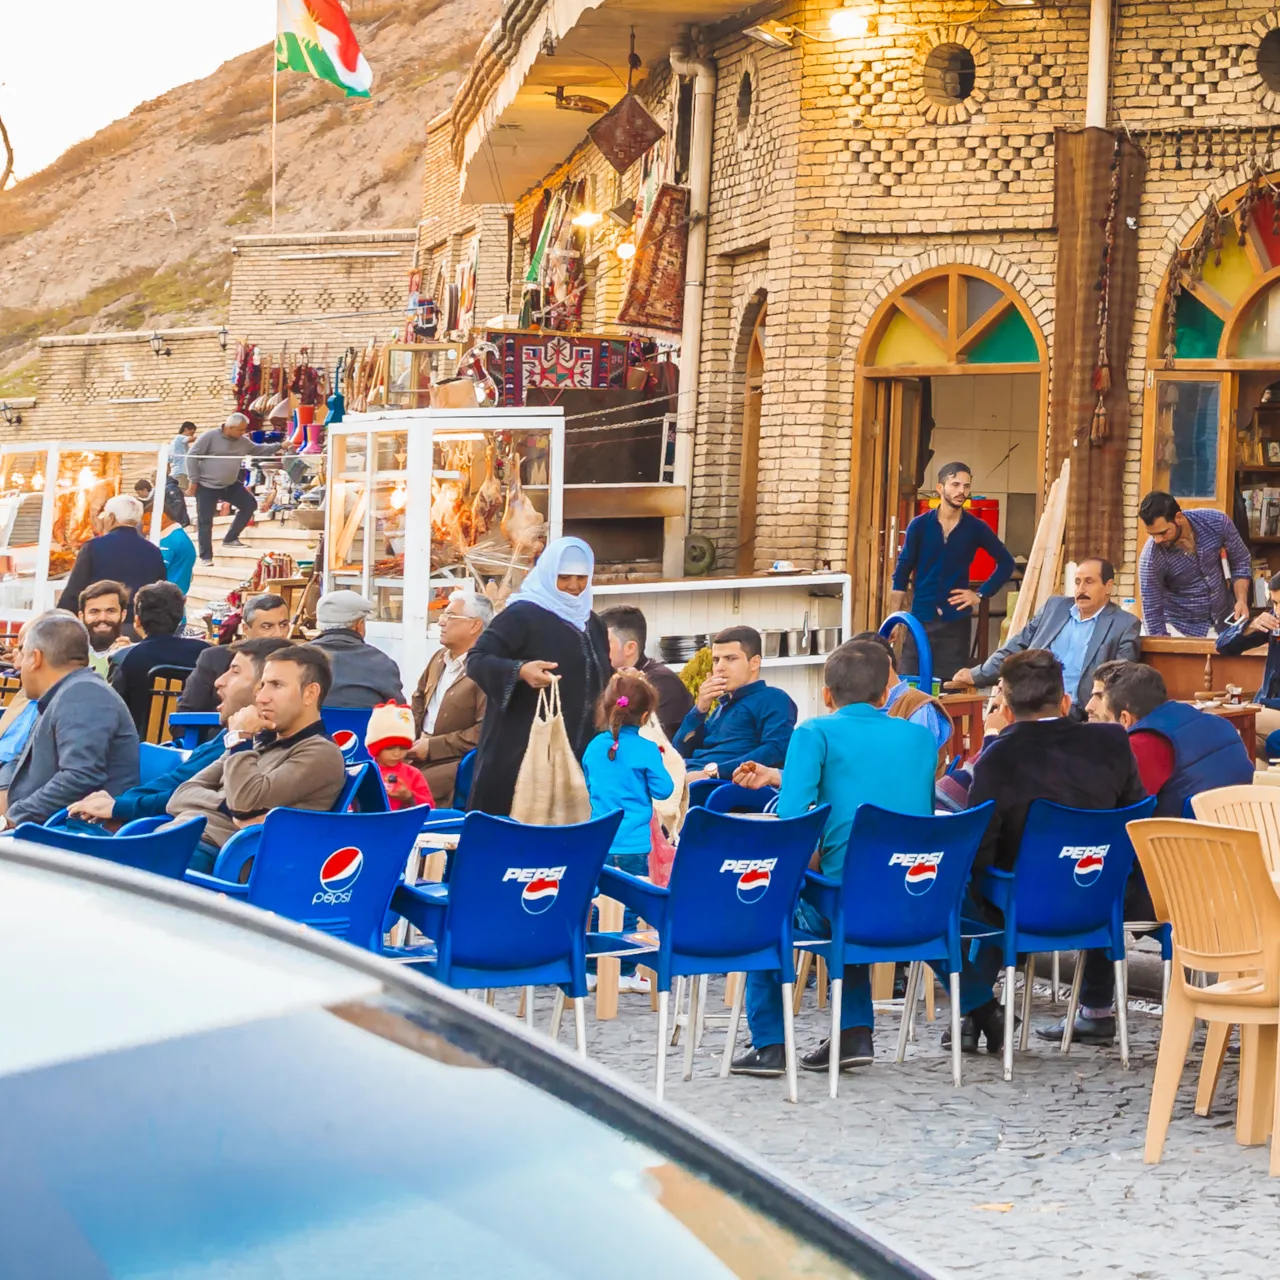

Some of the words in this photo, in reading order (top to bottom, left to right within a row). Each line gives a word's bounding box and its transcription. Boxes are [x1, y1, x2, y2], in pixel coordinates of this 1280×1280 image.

[888, 851, 944, 867] PEPSI
[1058, 844, 1110, 859] PEPSI
[719, 857, 778, 873] PEPSI
[502, 866, 567, 882] PEPSI
[312, 889, 353, 905] pepsi
